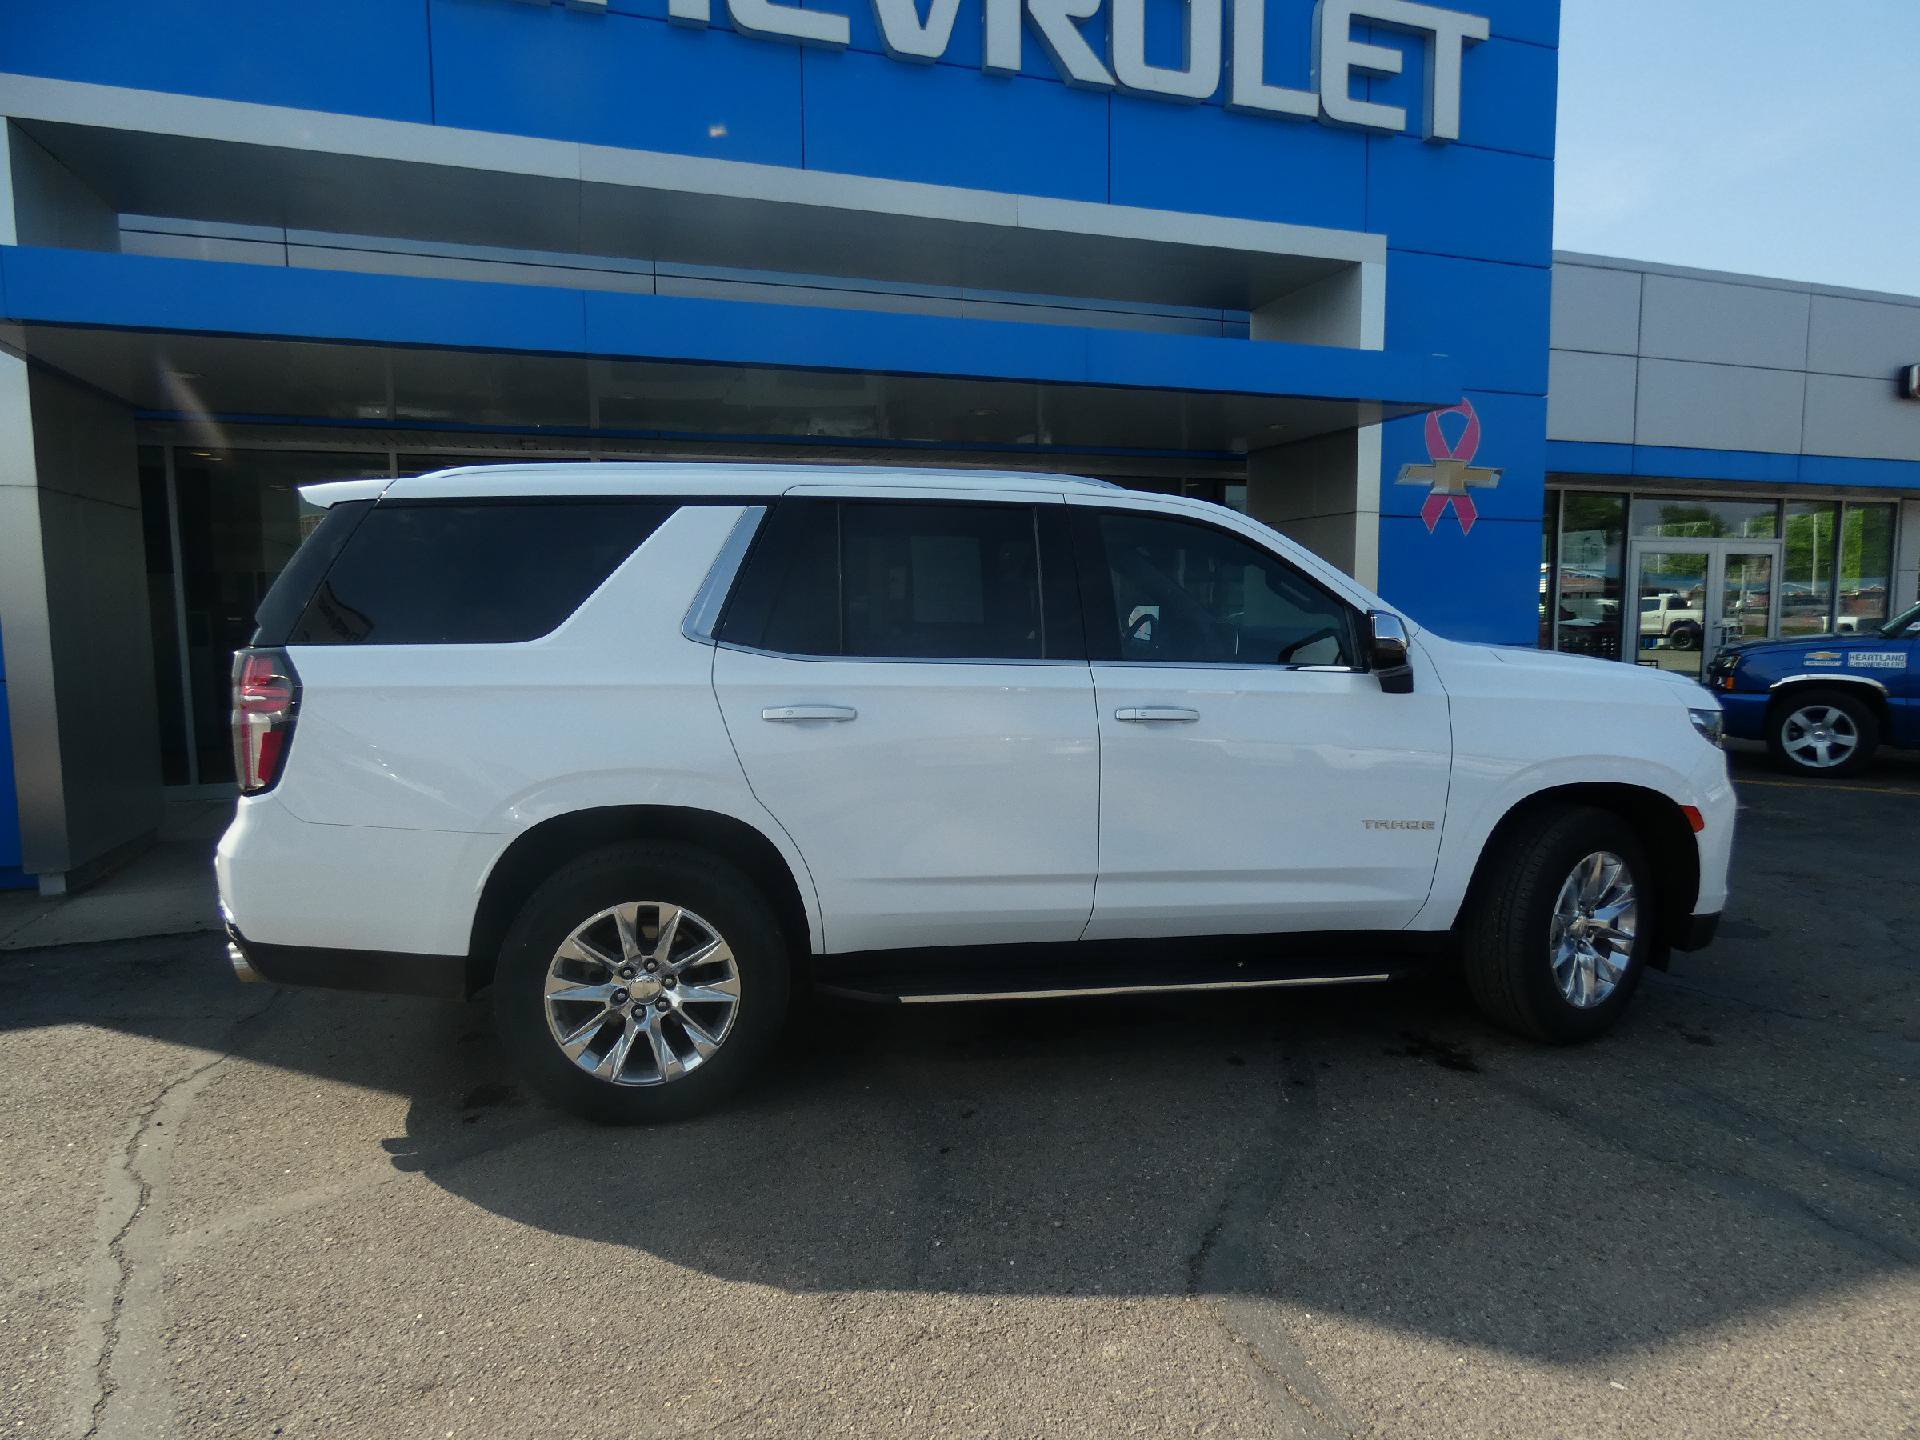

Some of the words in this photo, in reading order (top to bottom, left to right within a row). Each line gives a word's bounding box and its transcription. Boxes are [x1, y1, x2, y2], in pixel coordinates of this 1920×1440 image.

[527, 0, 1490, 143] ROLET
[1849, 653, 1905, 661] HEARTLAND
[1362, 819, 1435, 830] TAHOE
